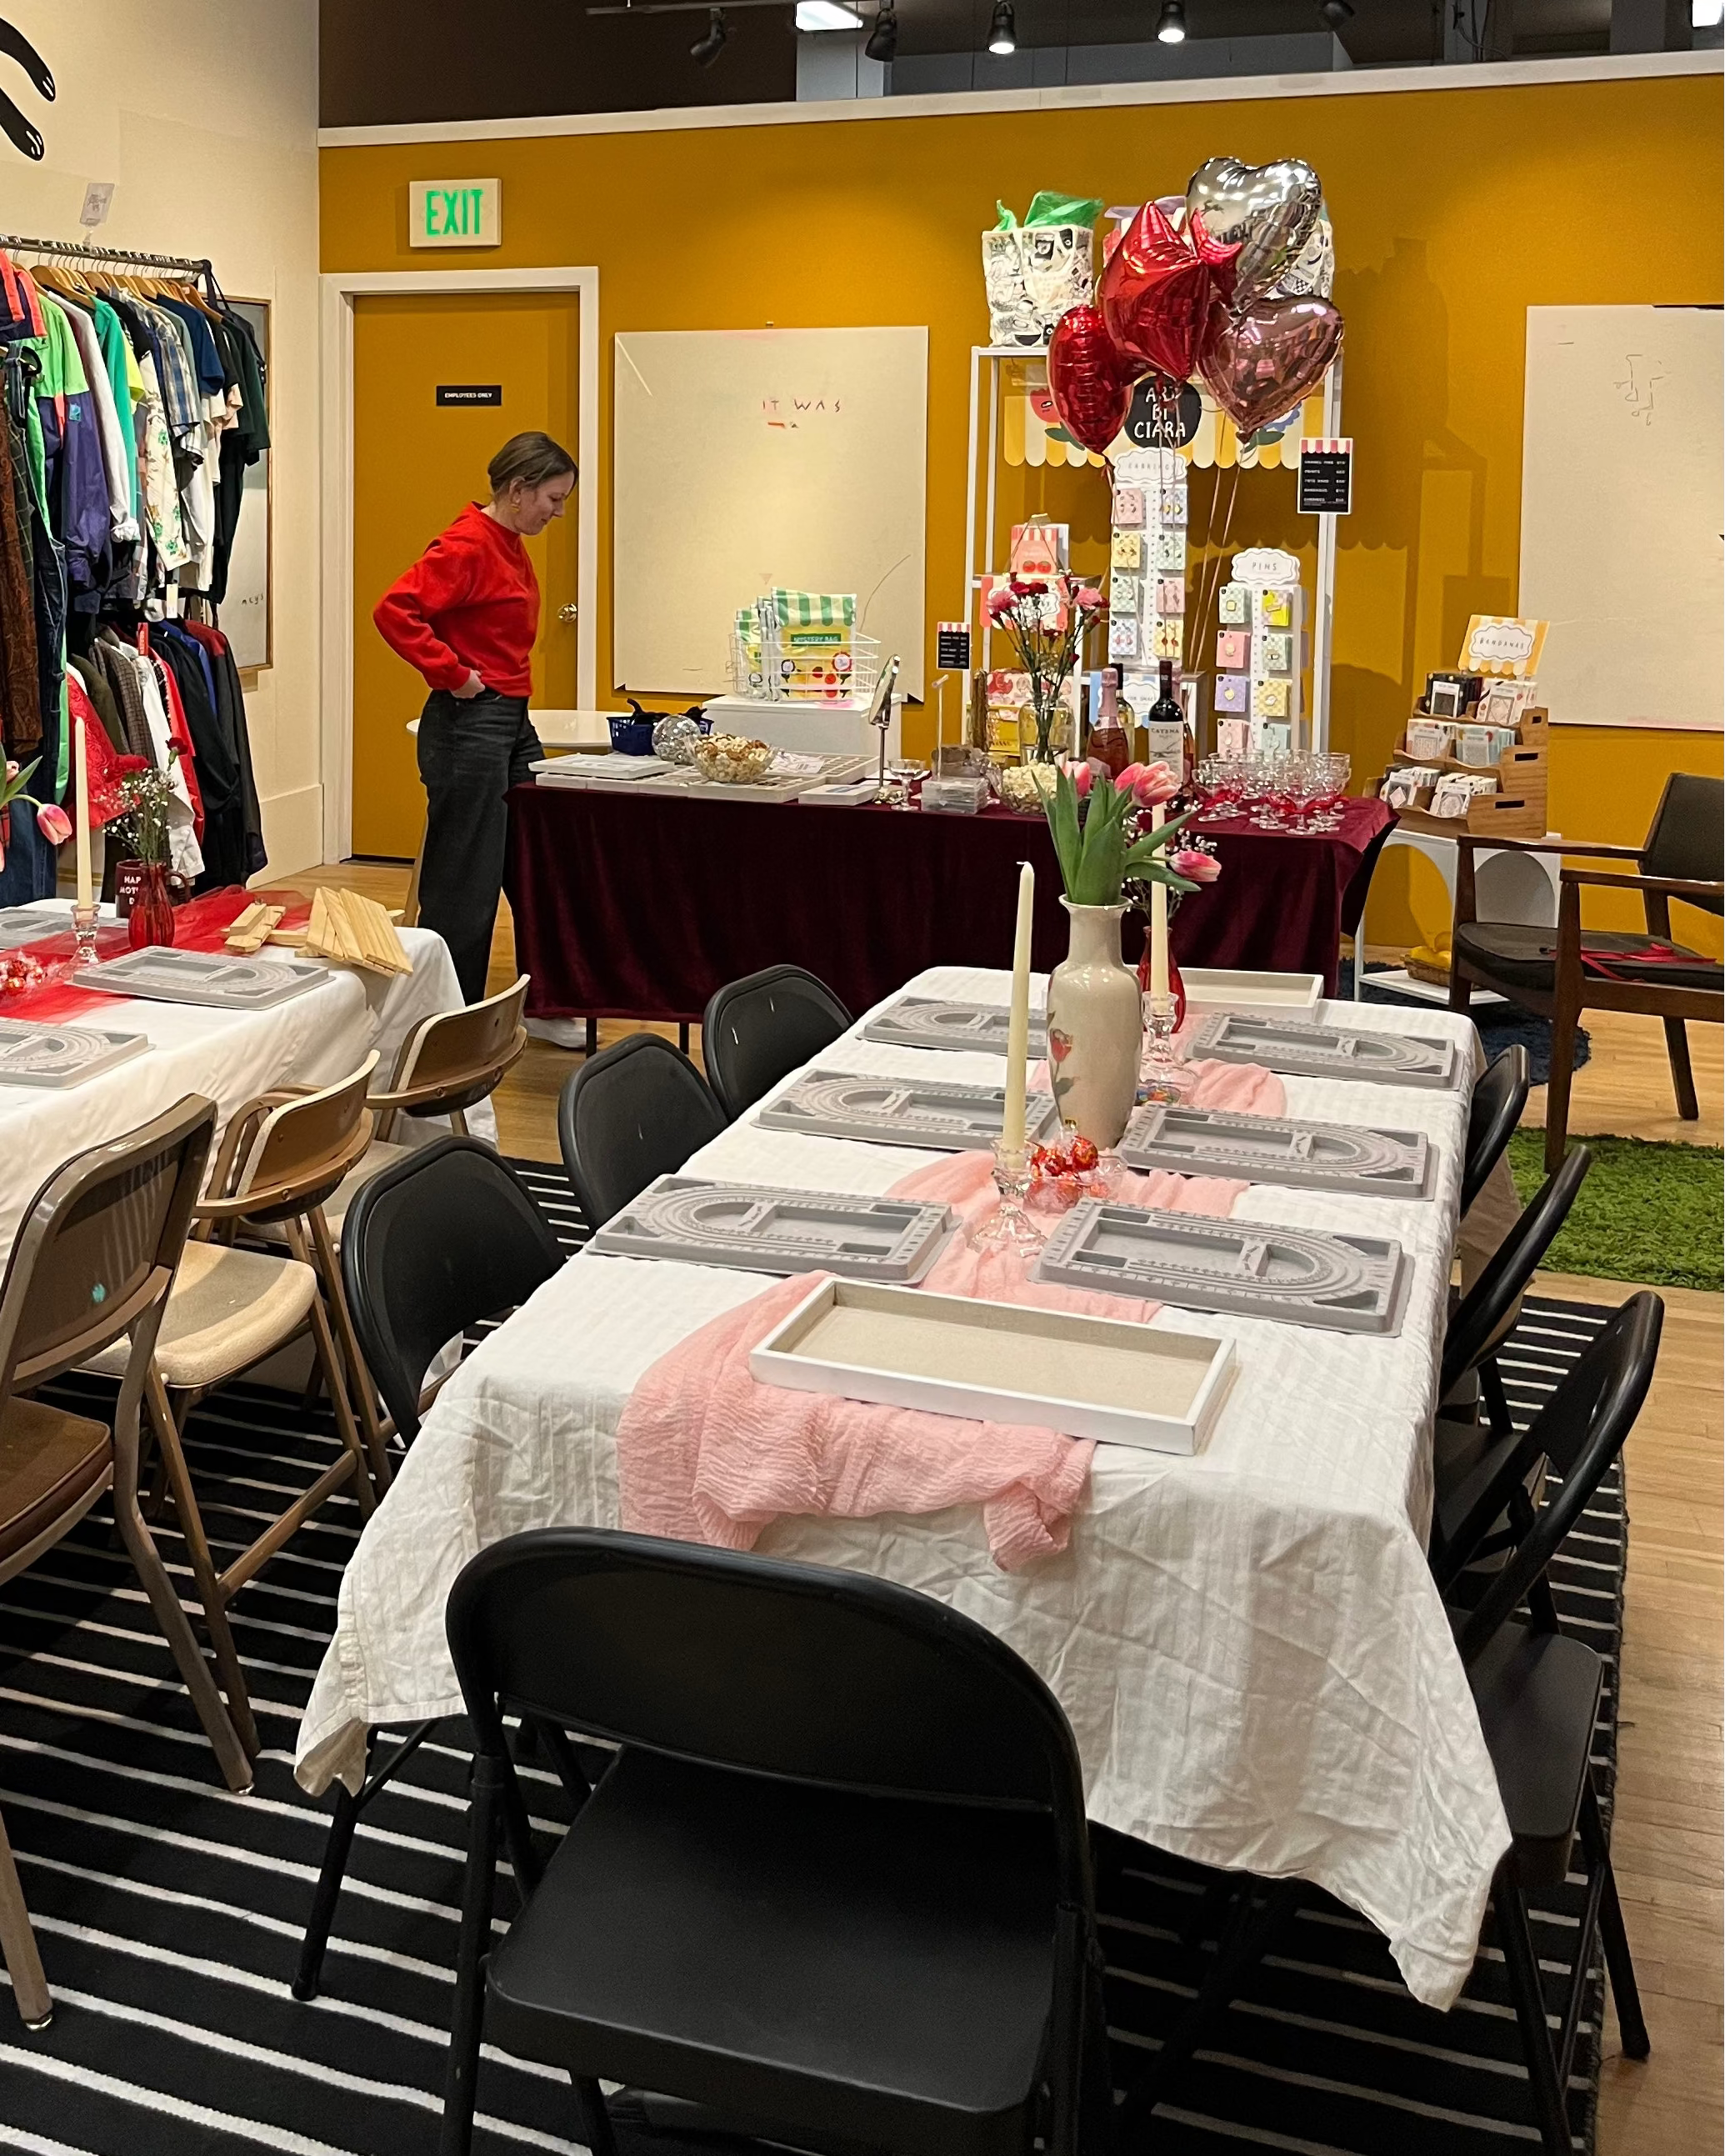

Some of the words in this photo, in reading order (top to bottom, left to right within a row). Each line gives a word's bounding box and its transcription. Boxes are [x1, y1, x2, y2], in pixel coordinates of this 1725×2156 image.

[426, 189, 483, 235] EXIT
[762, 400, 779, 410] IT
[794, 398, 840, 413] WAS
[1134, 421, 1186, 438] CIARA
[1252, 562, 1277, 571] PINS
[1479, 638, 1524, 649] BANDANAS
